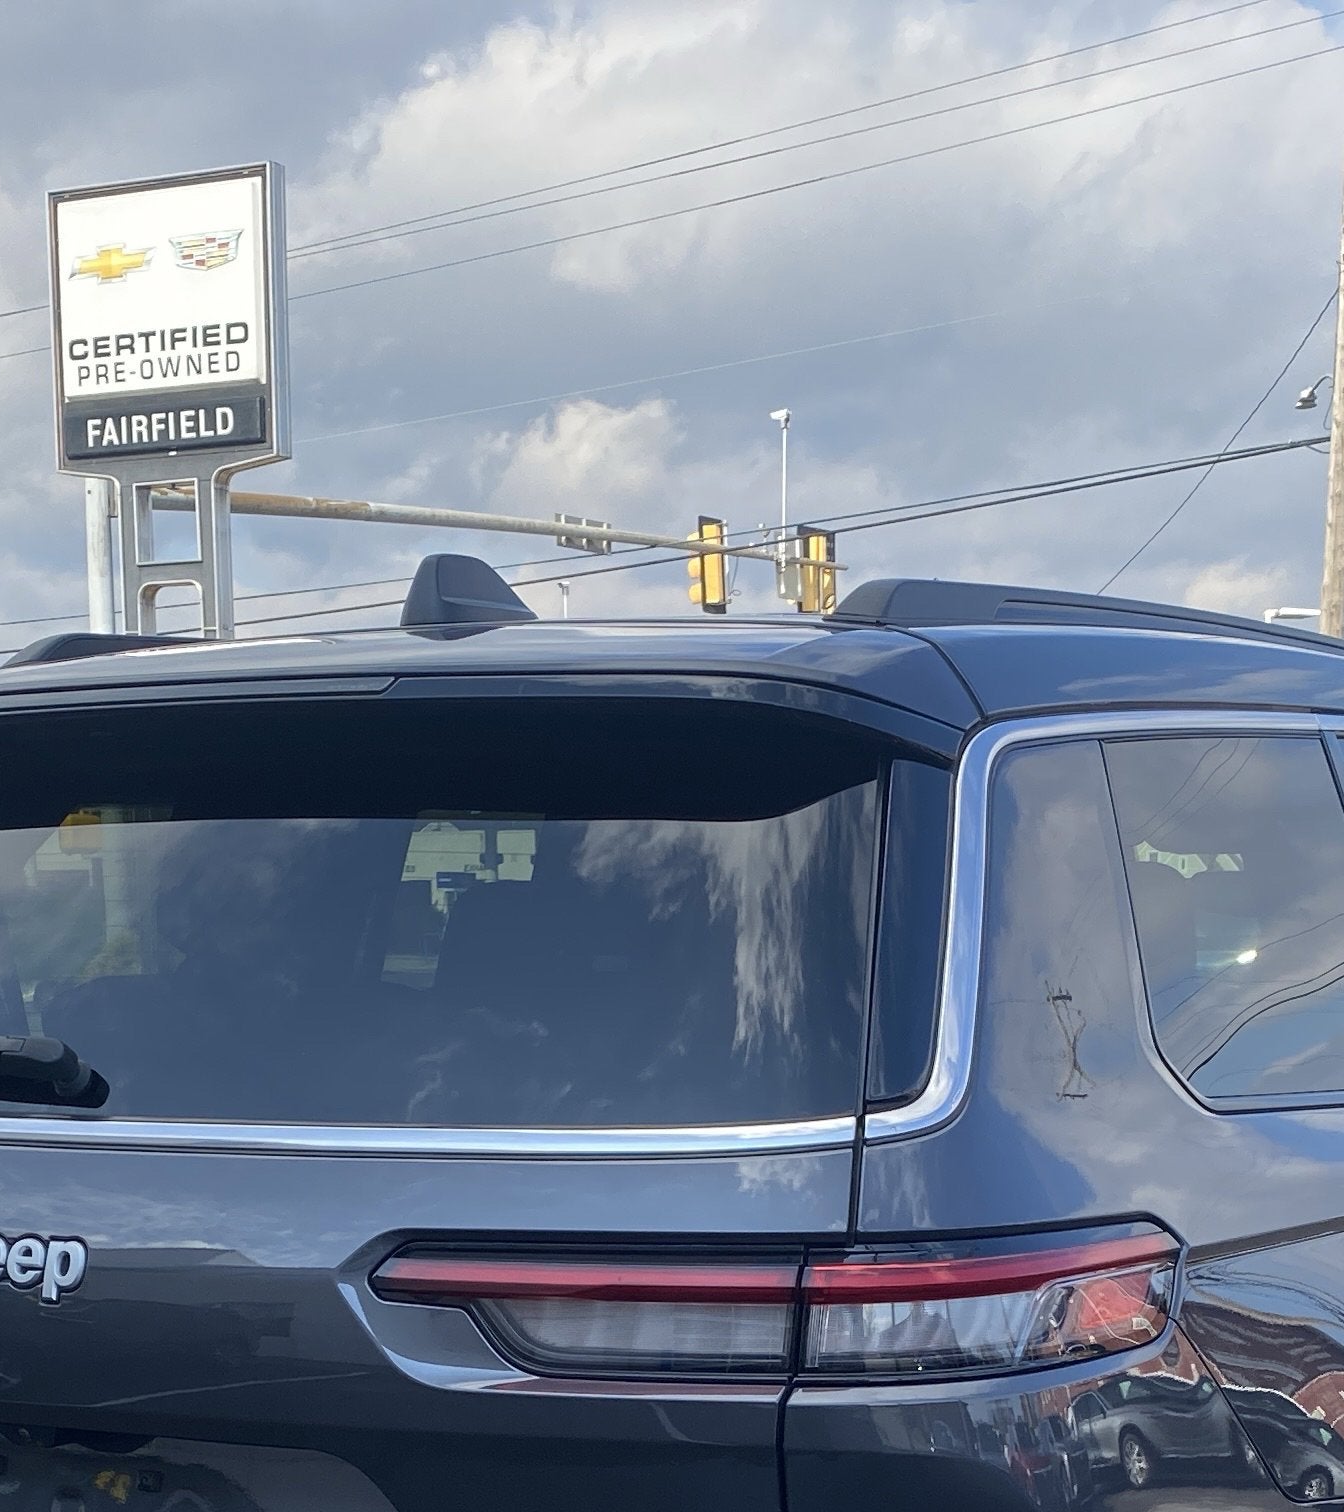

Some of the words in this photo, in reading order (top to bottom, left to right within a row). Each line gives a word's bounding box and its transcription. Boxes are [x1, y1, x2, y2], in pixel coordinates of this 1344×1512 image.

[68, 322, 249, 361] CERTIFIED
[77, 351, 240, 386] PRE-OWNED
[87, 406, 234, 448] FAIRFIELD
